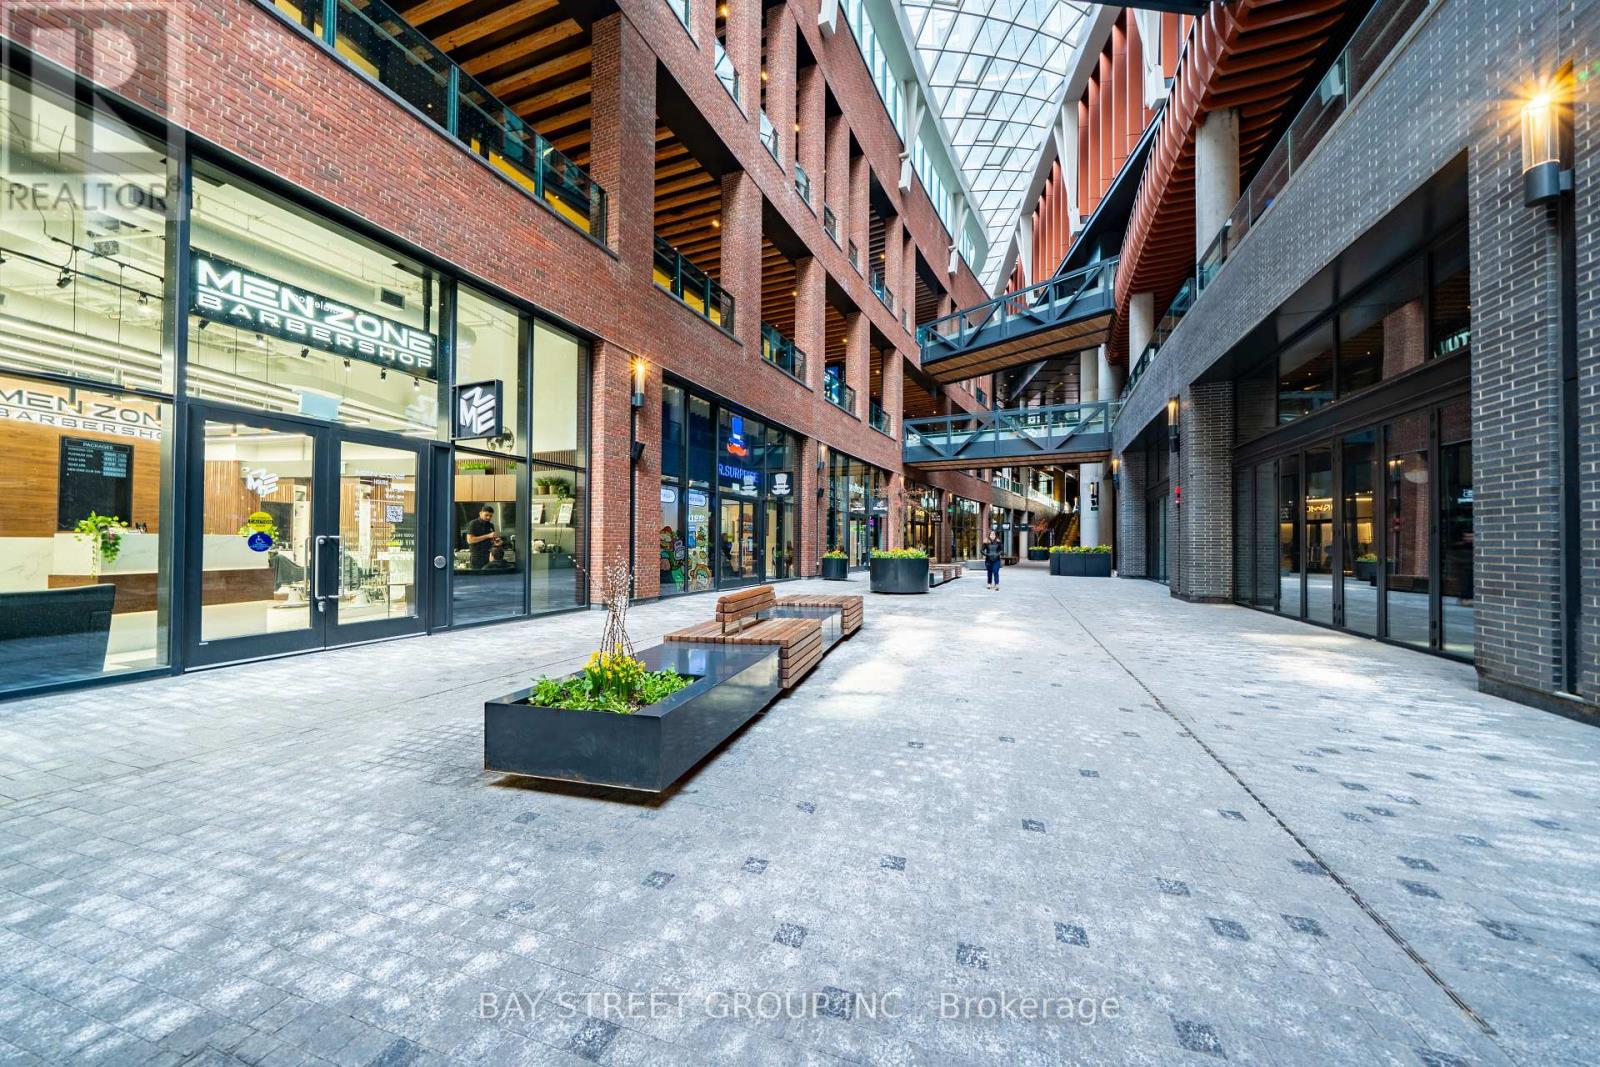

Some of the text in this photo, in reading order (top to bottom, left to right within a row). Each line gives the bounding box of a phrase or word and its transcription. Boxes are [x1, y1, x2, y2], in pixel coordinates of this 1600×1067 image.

[197, 258, 315, 319] MEN
[324, 303, 433, 355] ZONE
[198, 292, 433, 369] BARBERSHOP
[0, 389, 160, 428] MEN ZON
[718, 463, 760, 483] R.SURPRISE
